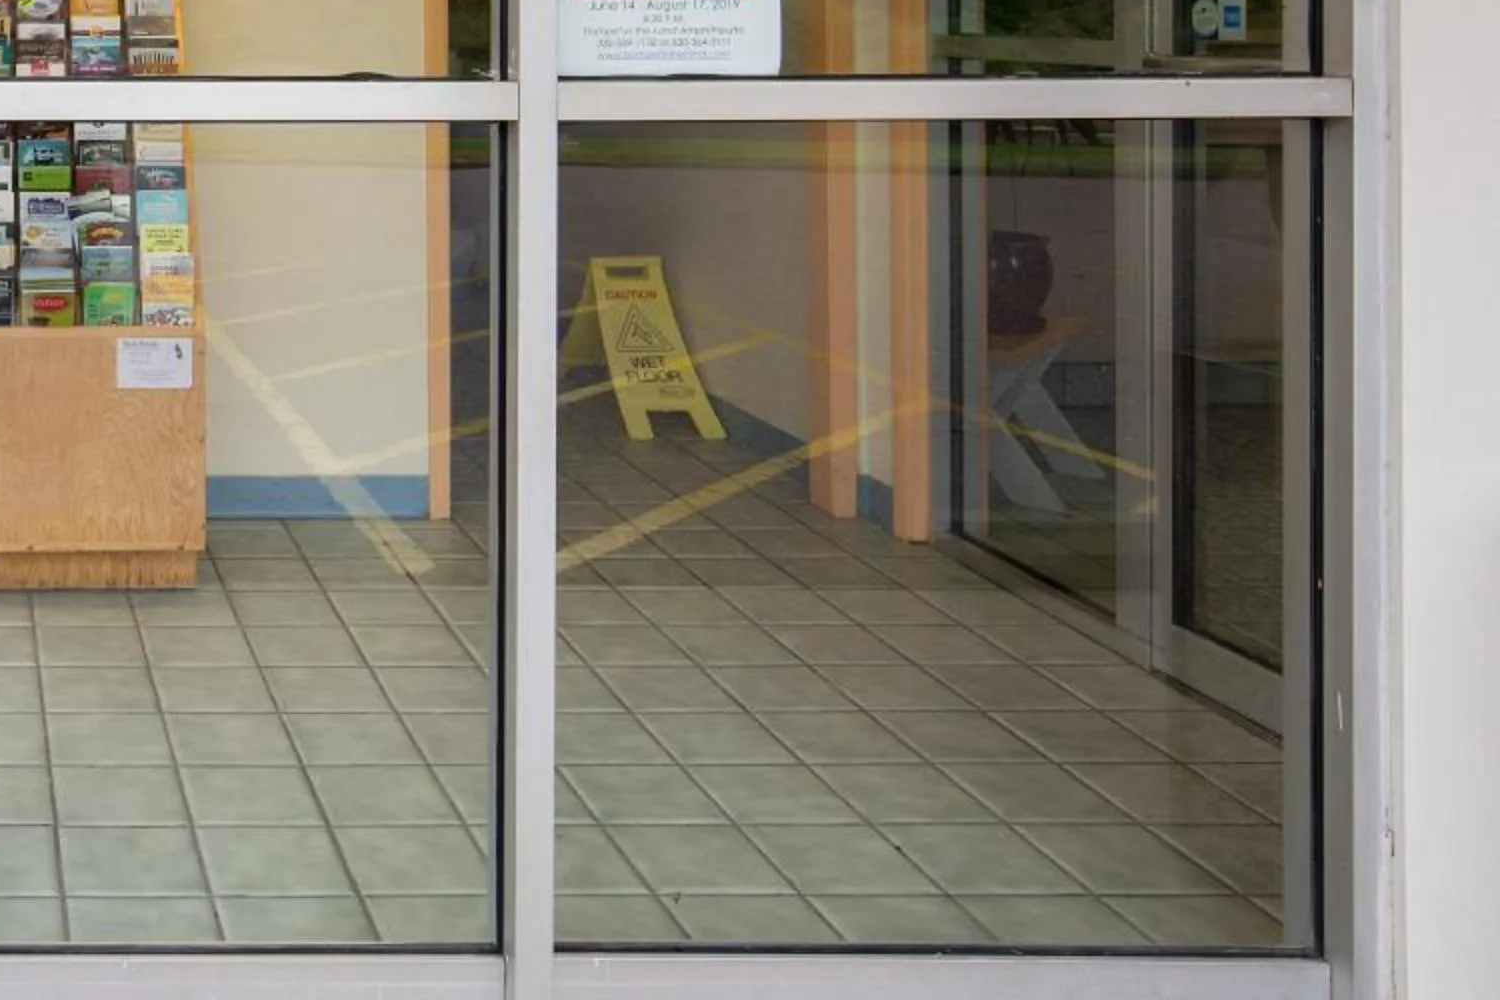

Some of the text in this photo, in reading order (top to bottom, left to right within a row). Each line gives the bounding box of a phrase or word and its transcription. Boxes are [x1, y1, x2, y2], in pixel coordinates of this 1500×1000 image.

[588, 0, 618, 11] June
[646, 0, 687, 12] August
[605, 289, 657, 301] CAUTION
[629, 356, 666, 369] WET
[624, 370, 684, 384] FLOOR
